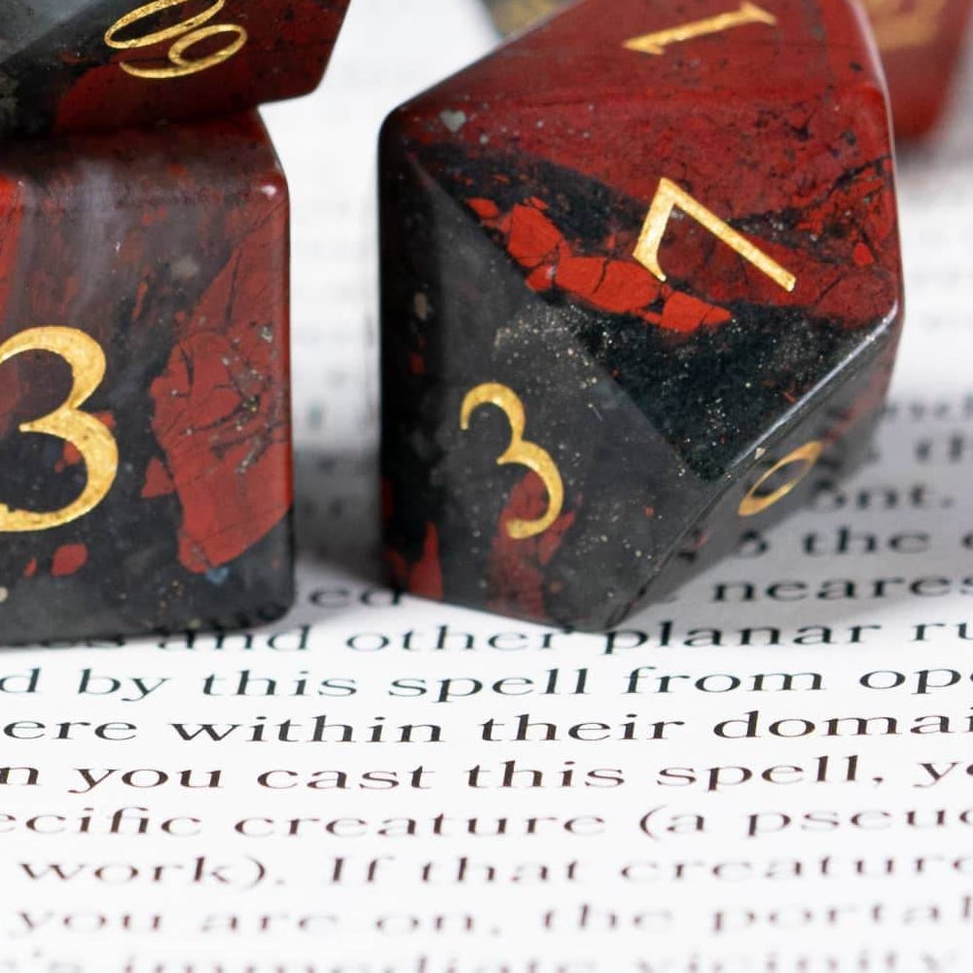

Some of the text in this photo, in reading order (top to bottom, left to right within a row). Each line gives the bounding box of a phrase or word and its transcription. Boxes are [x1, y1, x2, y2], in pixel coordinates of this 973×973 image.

[621, 2, 777, 56] 1
[632, 177, 797, 292] 7
[460, 382, 564, 539] 3
[345, 622, 575, 653] other
[600, 619, 882, 656] planar
[77, 668, 170, 702] by
[202, 668, 357, 697] this
[388, 667, 589, 704] spell
[623, 666, 824, 695] from
[859, 669, 973, 695] op
[169, 714, 444, 744] within
[479, 713, 686, 742] their
[67, 765, 222, 794] you
[256, 765, 435, 790] cast
[467, 759, 626, 789] this
[656, 754, 884, 793] spell,
[233, 811, 605, 838] creature
[638, 804, 707, 842] (a
[17, 855, 285, 889] work).
[330, 856, 397, 885] If
[420, 855, 580, 885] that
[17, 910, 164, 938] you
[200, 913, 338, 933] are
[374, 912, 501, 936] on.
[541, 902, 673, 931] the
[711, 893, 973, 934] portal
